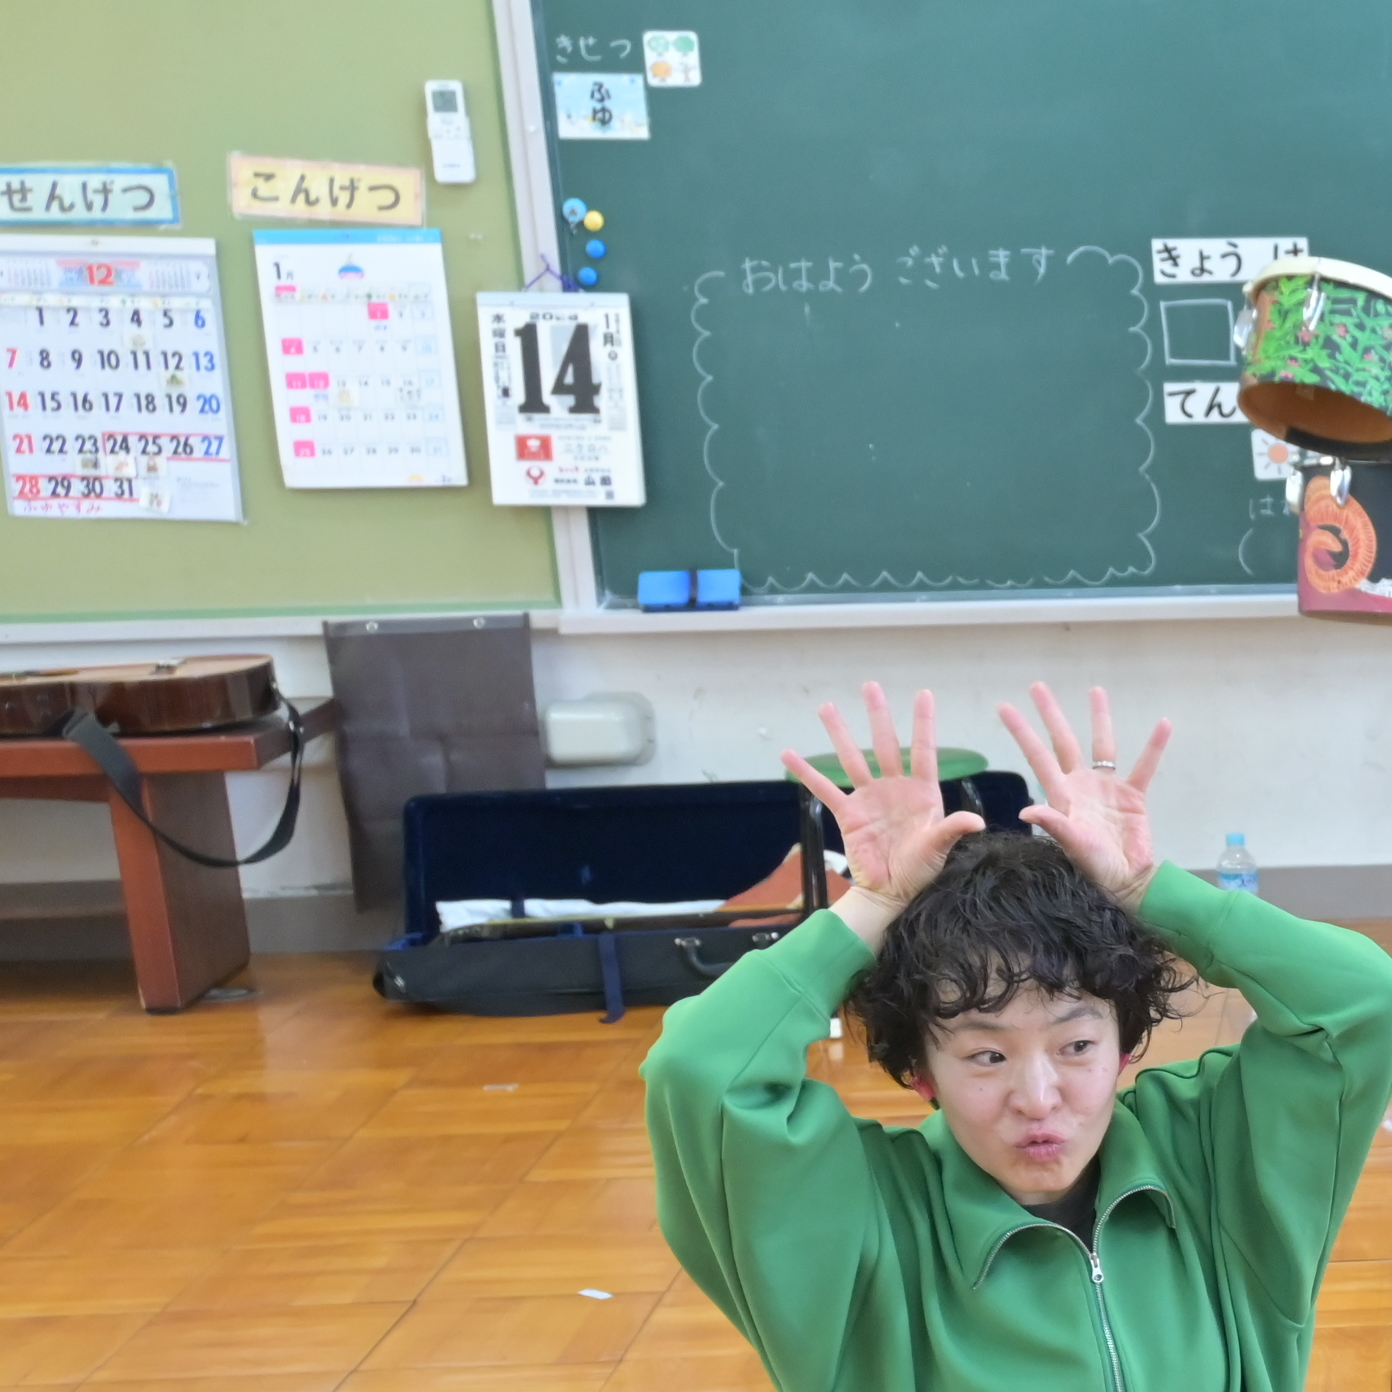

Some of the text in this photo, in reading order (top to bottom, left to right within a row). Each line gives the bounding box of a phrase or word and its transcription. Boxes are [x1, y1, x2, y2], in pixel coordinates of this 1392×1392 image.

[555, 33, 632, 64] きせつ
[590, 81, 613, 126] ふゆ
[1, 180, 156, 214] せんげつ
[250, 171, 401, 211] こんげつ
[86, 263, 115, 286] 12
[740, 244, 1056, 294] おはよう ございます
[1155, 240, 1243, 279] きょう
[36, 307, 206, 329] 1 2 3 4 5 6
[6, 348, 216, 372] 7 8 9 10 11 12 13
[514, 322, 602, 414] 14
[6, 391, 222, 415] 14 15 16 17 18 19 20
[12, 434, 225, 457] 21 22 23 24 25 26 27
[15, 476, 134, 499] 28 29 30 31
